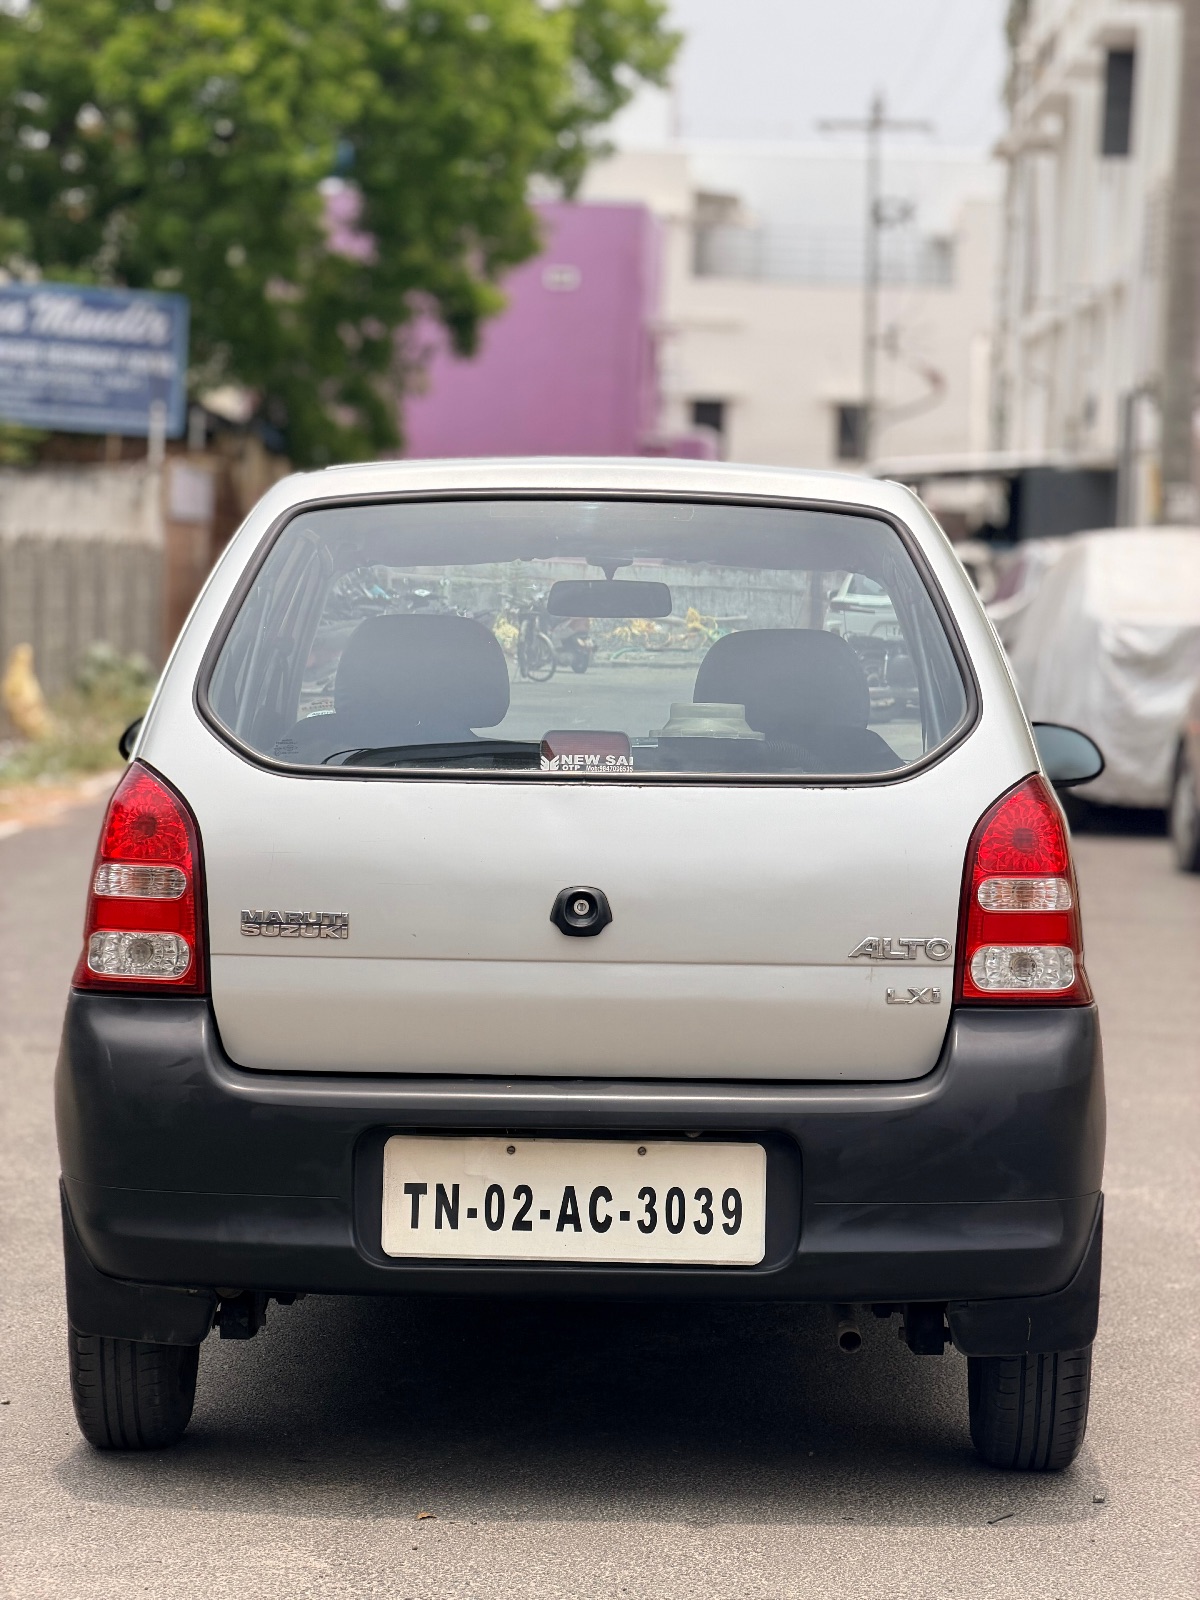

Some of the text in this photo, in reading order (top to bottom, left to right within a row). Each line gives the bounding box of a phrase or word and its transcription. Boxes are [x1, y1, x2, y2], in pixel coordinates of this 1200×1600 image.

[561, 754, 634, 766] NEW SAI
[241, 909, 349, 925] MARUTI
[241, 923, 349, 939] SUZUKI
[848, 936, 953, 961] ALTO
[886, 986, 941, 1004] LXi
[403, 1182, 743, 1236] TN-02-AC-3039
